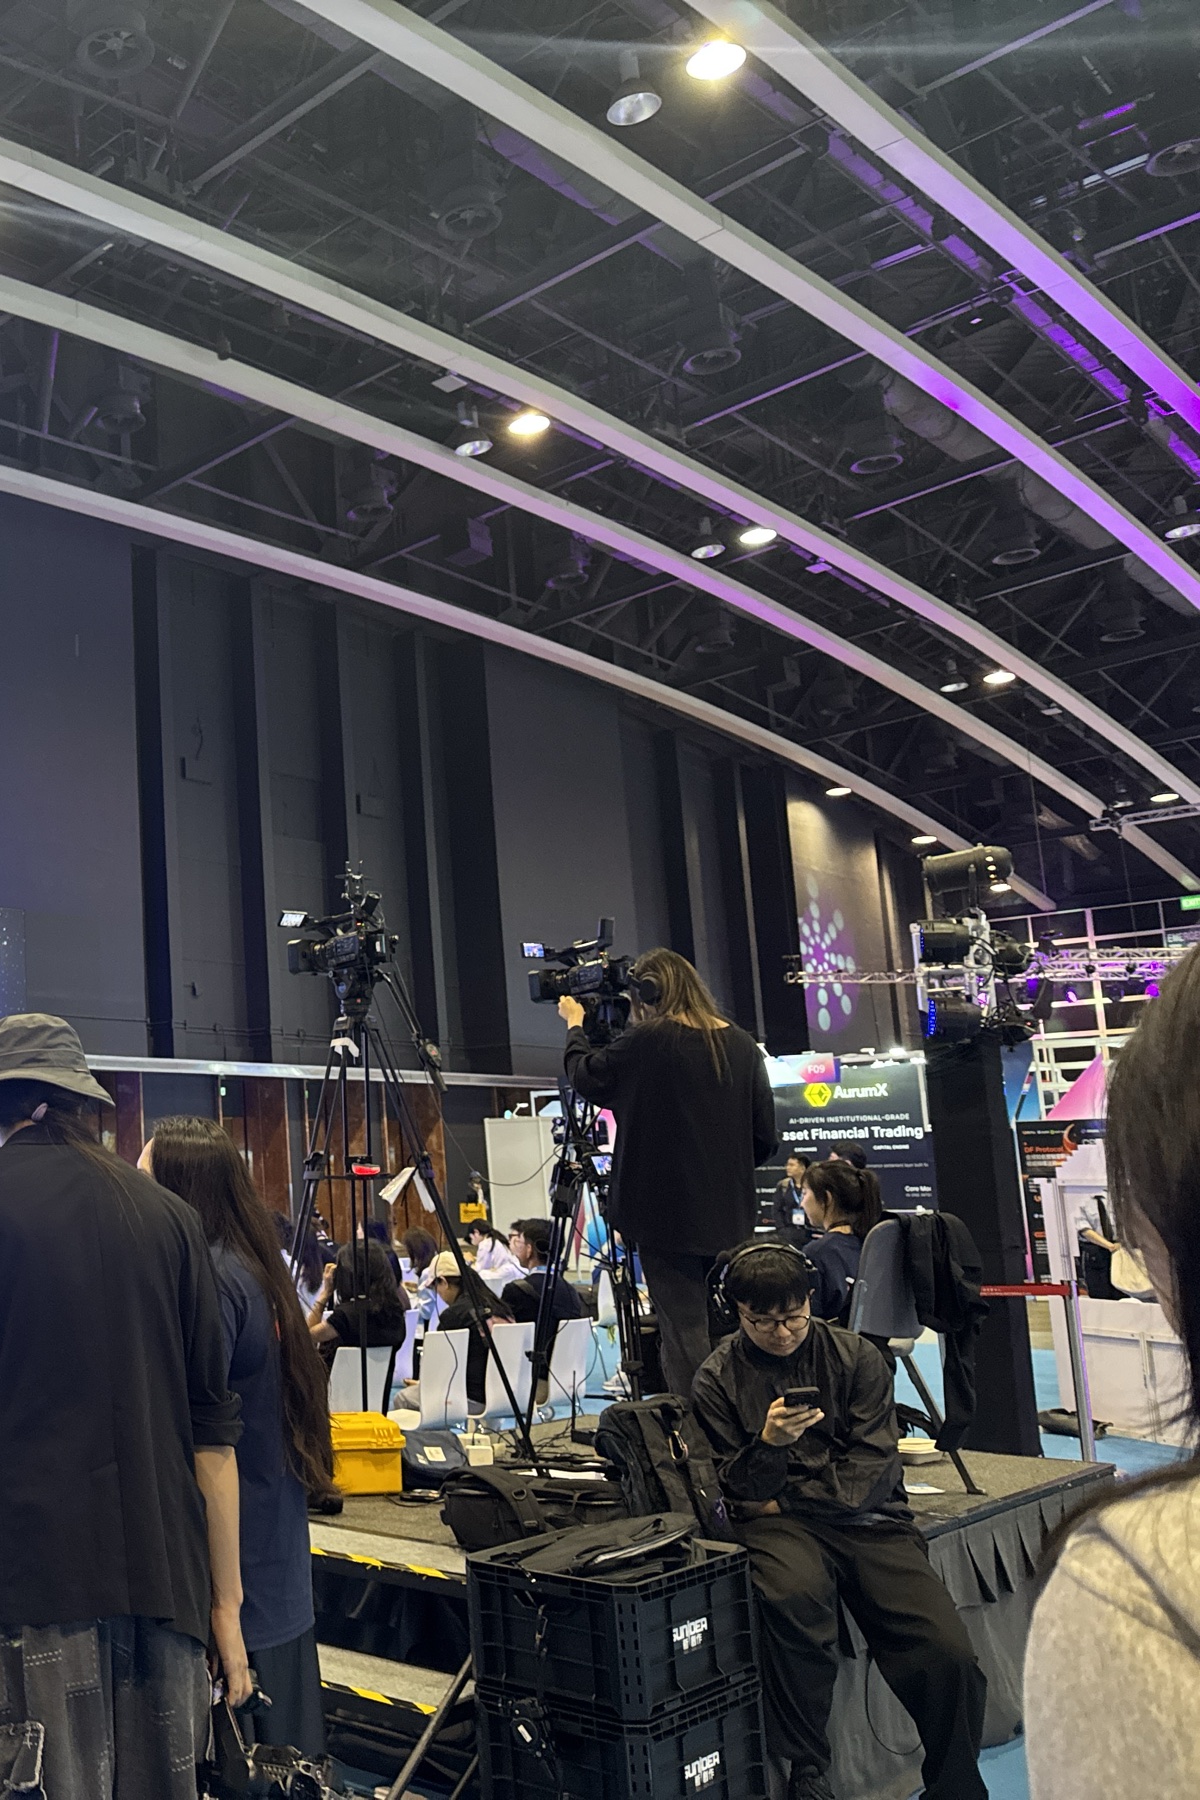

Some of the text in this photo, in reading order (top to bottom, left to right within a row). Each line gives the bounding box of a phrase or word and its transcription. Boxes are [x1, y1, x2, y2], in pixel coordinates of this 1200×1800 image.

[807, 1064, 826, 1074] F09
[833, 1083, 889, 1099] AurumX
[782, 1125, 924, 1141] sset Financial Trading
